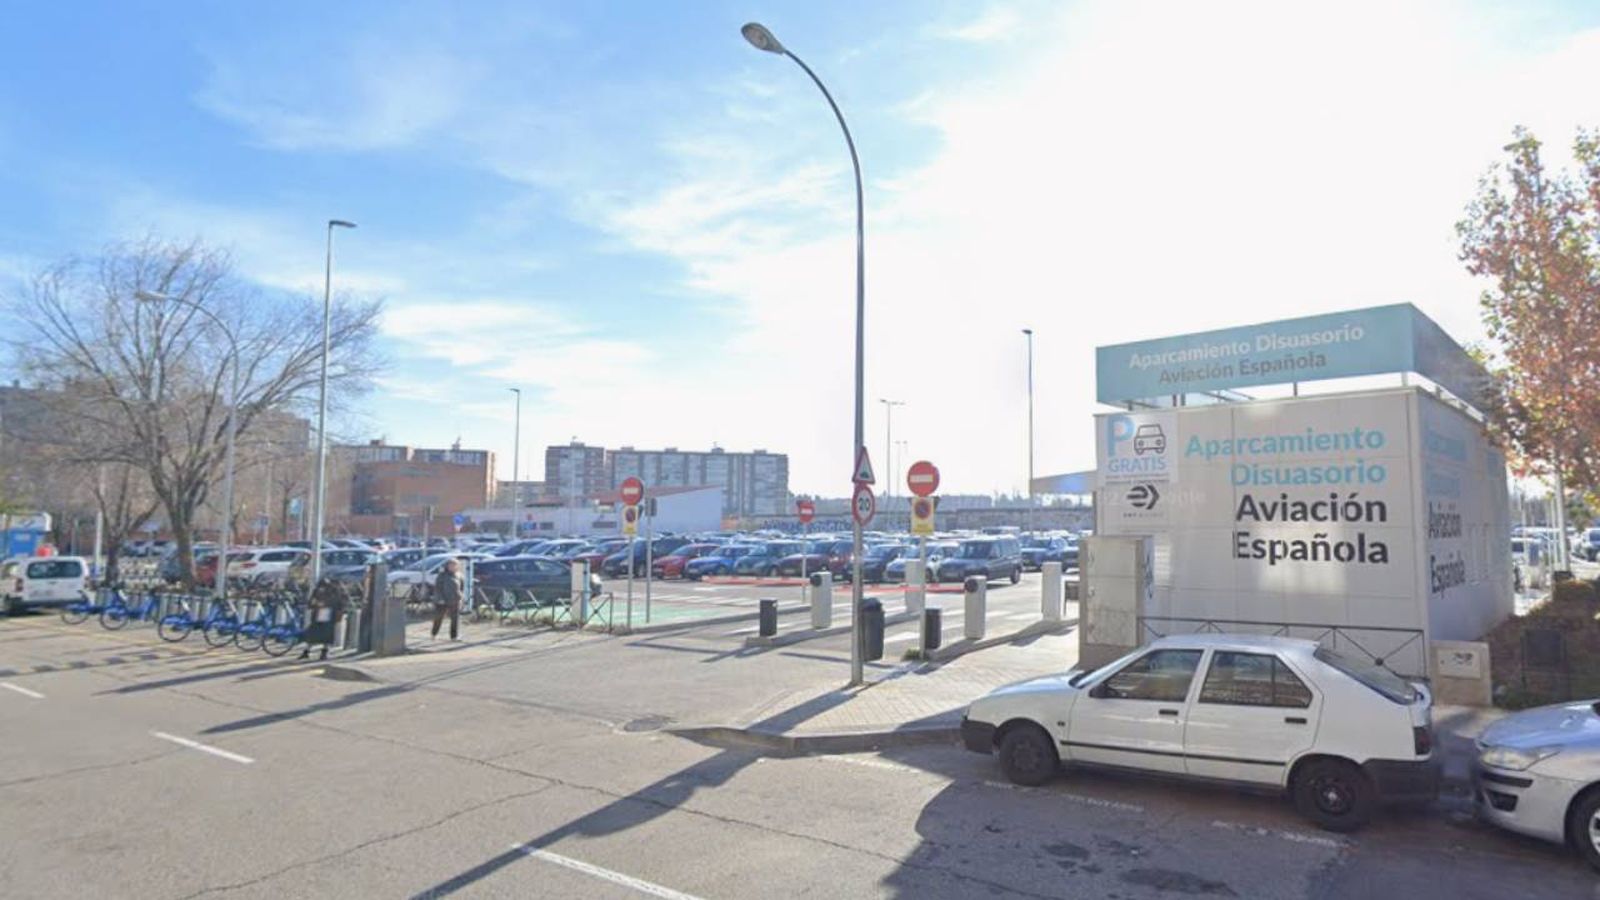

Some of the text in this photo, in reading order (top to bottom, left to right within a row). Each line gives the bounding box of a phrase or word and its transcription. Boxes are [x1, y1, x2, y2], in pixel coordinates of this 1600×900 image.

[1129, 323, 1364, 370] Aparcamiento Disuasorio
[1158, 351, 1327, 384] Aviación Española
[1185, 427, 1385, 461] Aparcamiento
[1109, 456, 1166, 473] GRATIS
[1231, 459, 1387, 486] Disuasorio
[858, 498, 870, 511] 20
[1236, 492, 1387, 523] Aviación
[1232, 532, 1389, 566] Española
